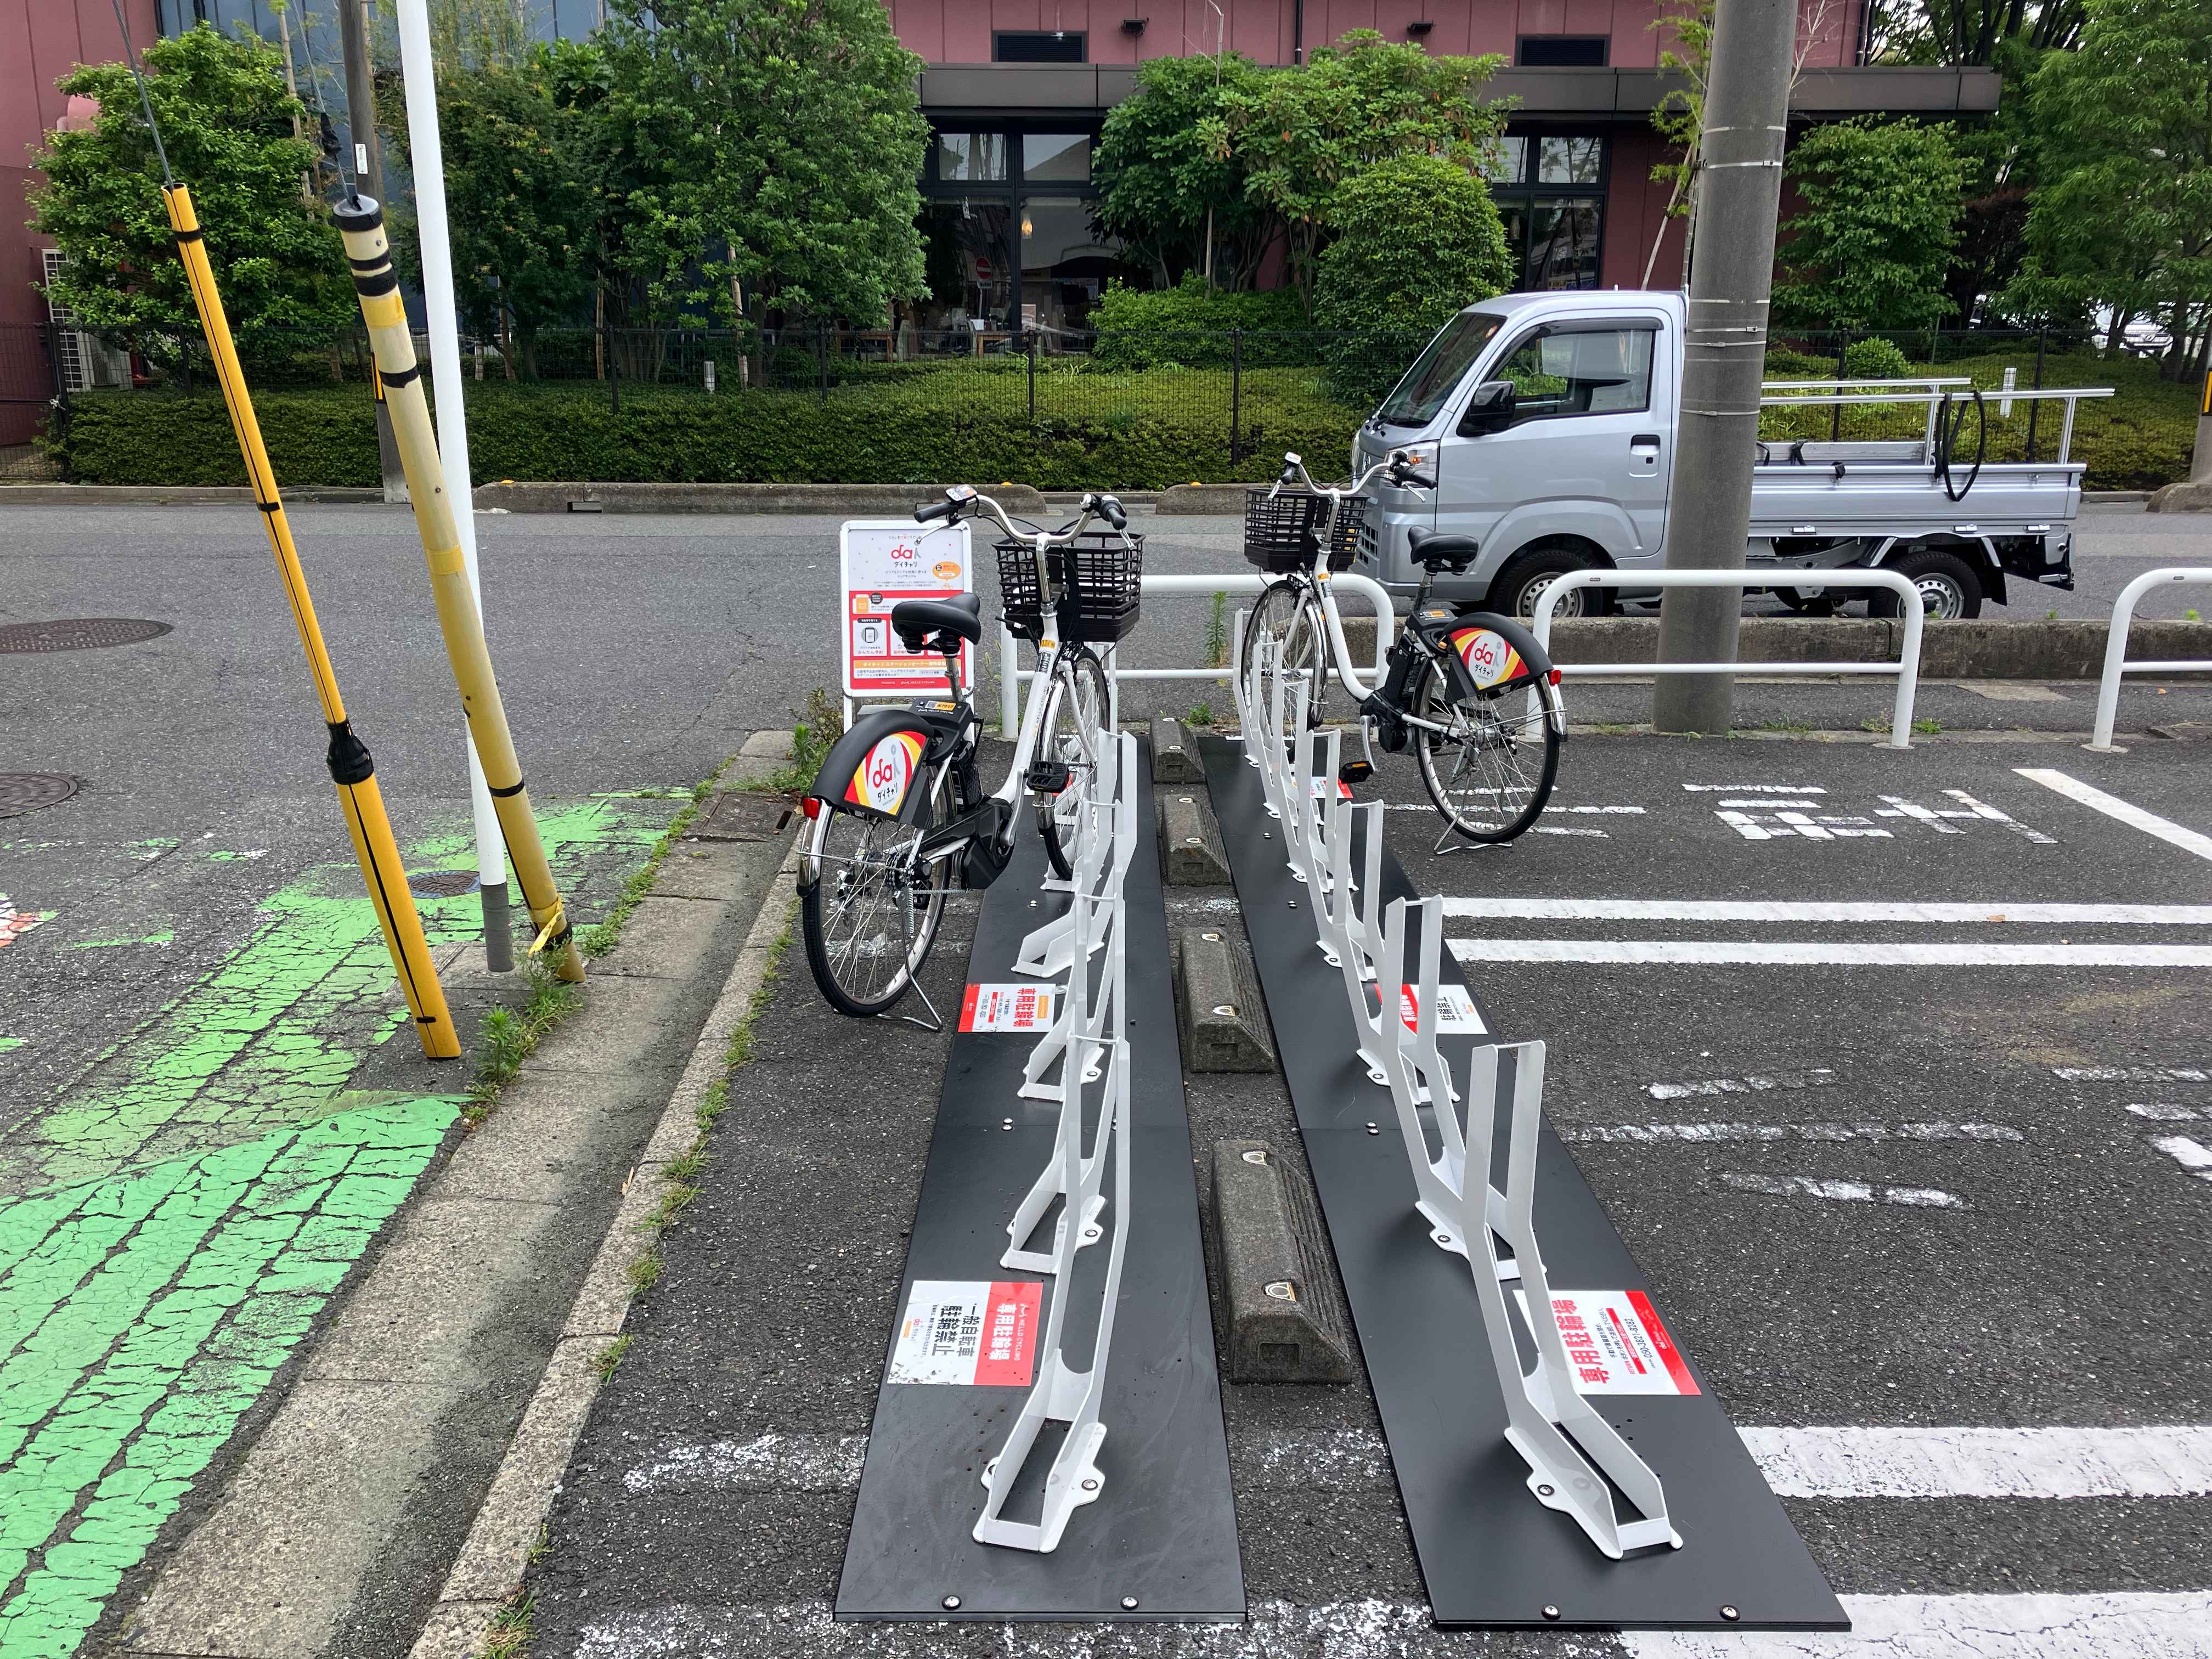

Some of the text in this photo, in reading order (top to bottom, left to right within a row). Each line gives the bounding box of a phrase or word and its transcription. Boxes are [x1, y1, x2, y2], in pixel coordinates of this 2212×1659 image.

[1475, 641, 1502, 667] dai
[1475, 664, 1494, 677] ダイチャリ
[873, 744, 900, 788] dai
[878, 782, 898, 803] ダイチャリ
[1013, 988, 1036, 1027] 専用駐輪場
[932, 1305, 962, 1357] 駐輪禁止
[956, 1306, 981, 1357] 一般自転車
[989, 1304, 1017, 1360] 専用駐輪場
[1013, 1319, 1025, 1361] HELLO CYCLING
[1552, 1300, 1610, 1384] 専用駐輪場
[1624, 1318, 1652, 1358] 050-3821-8282
